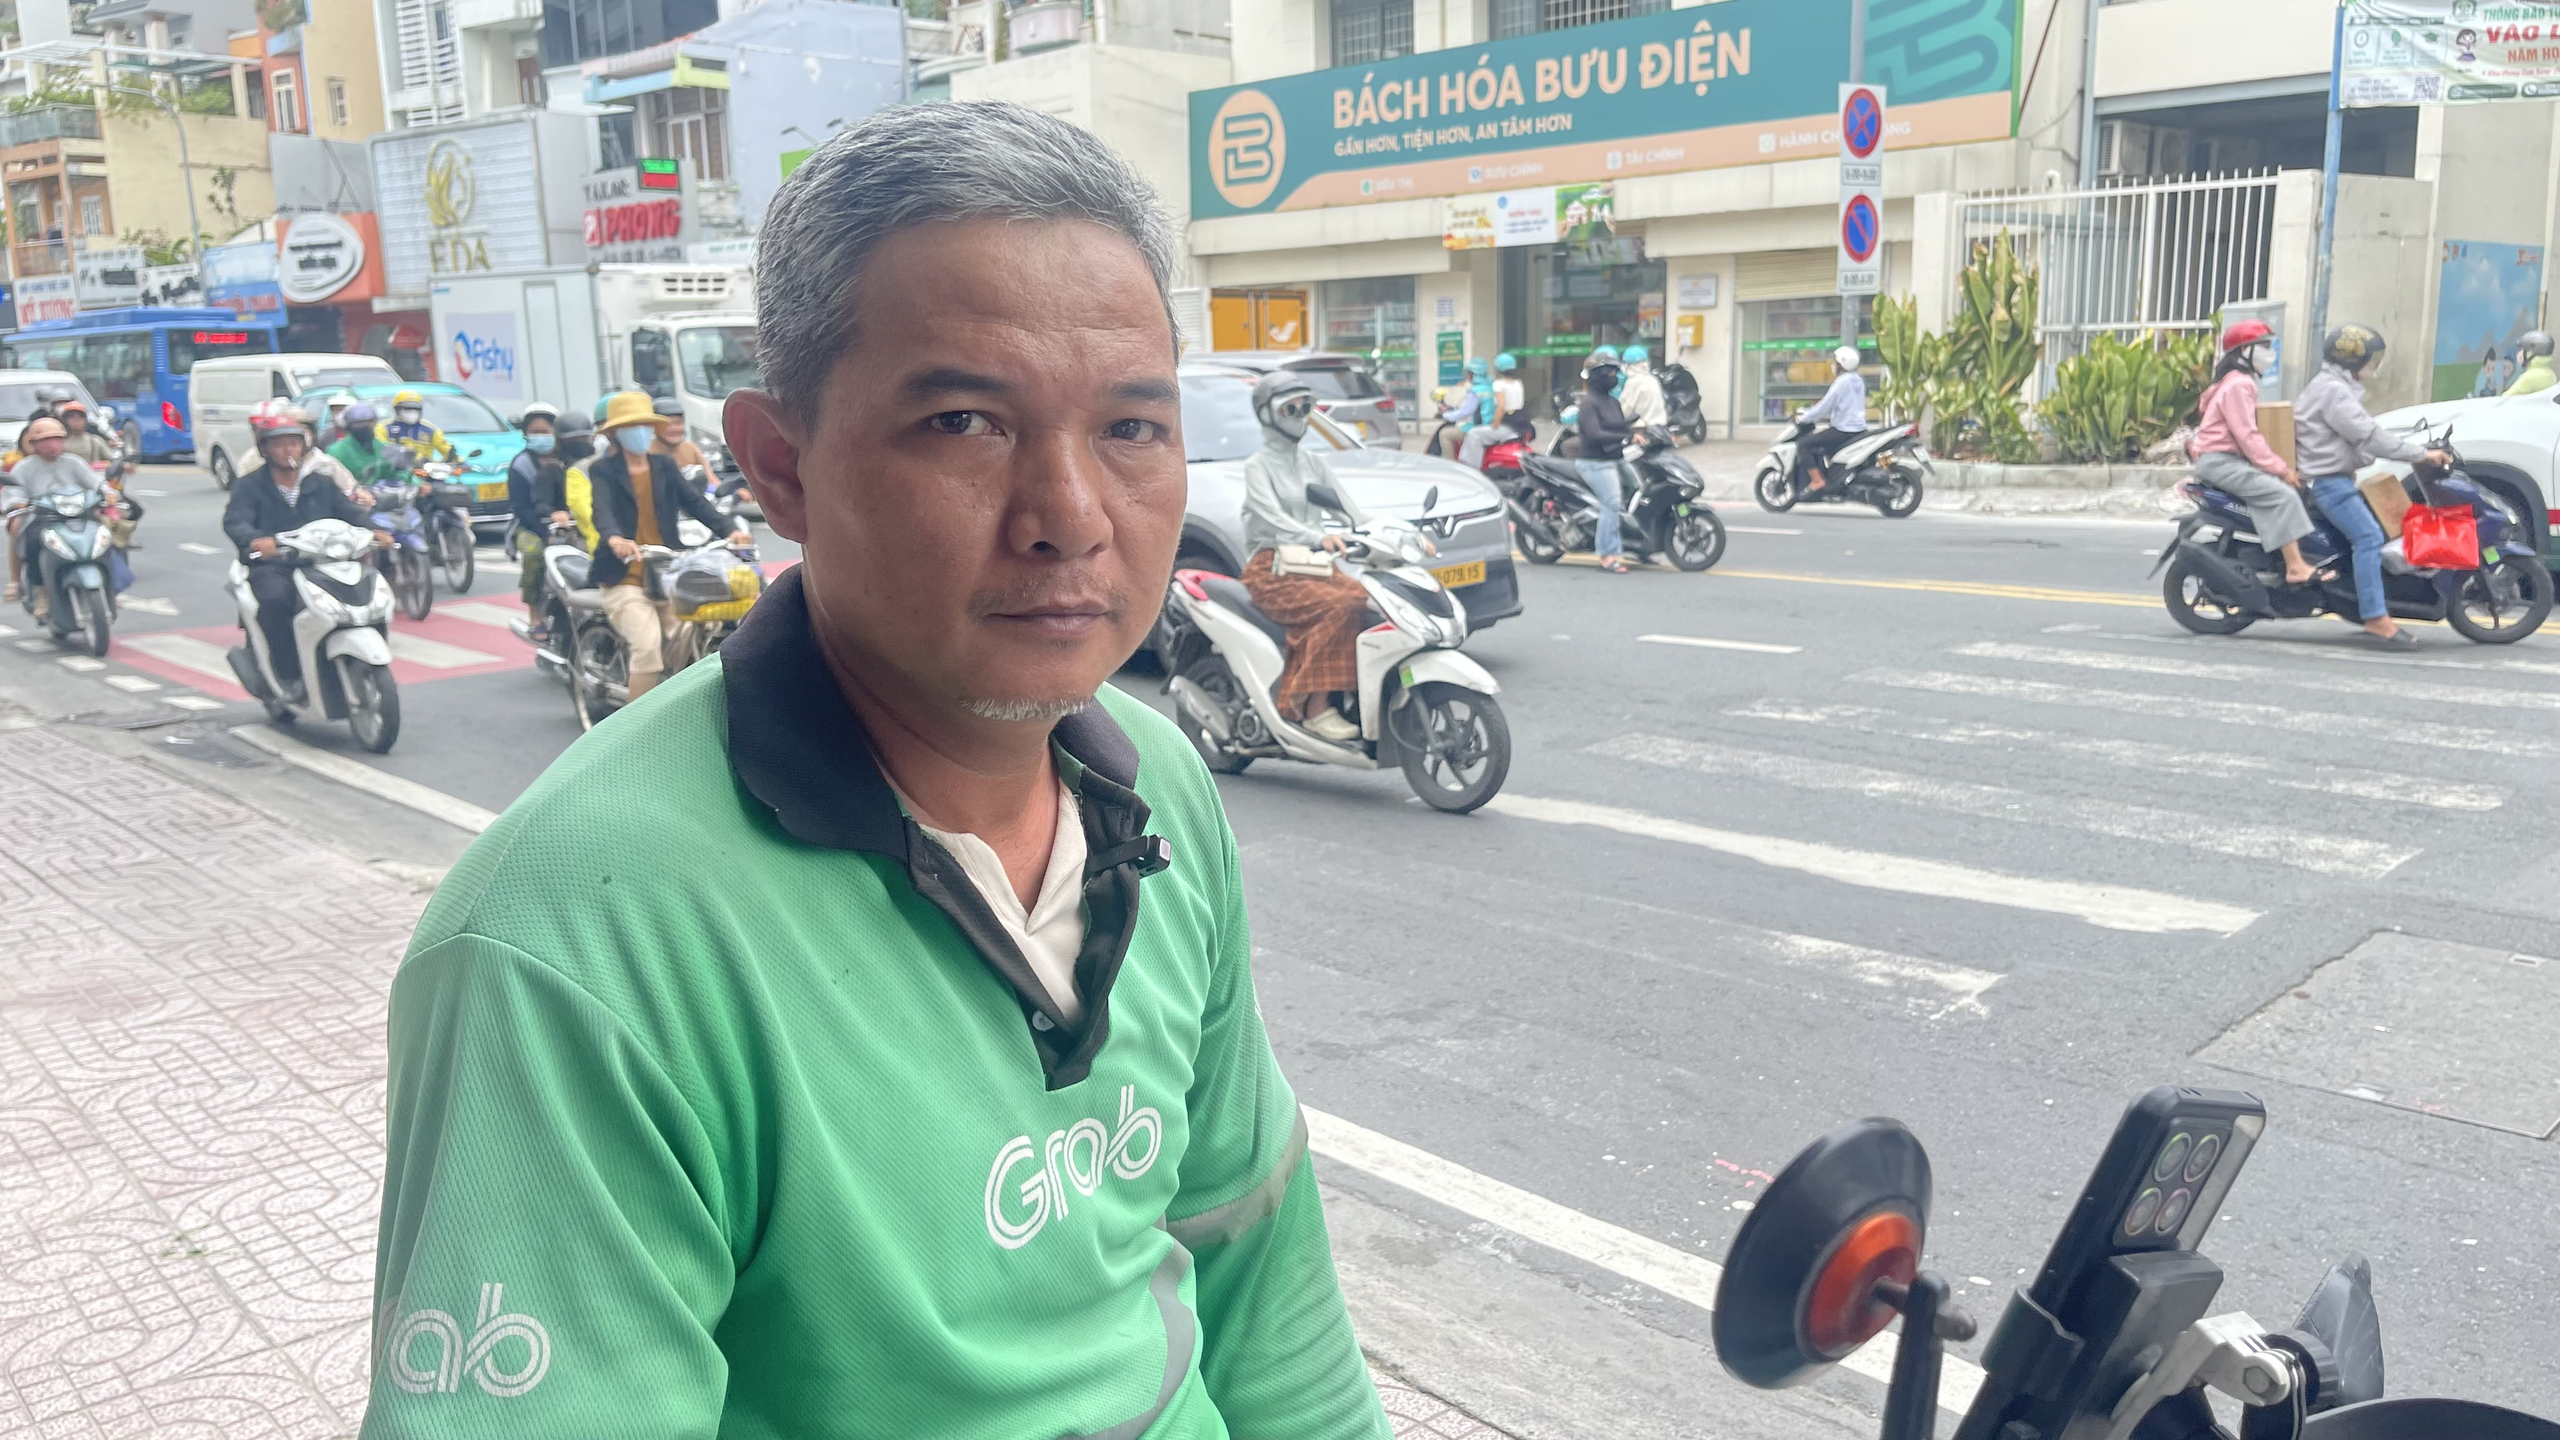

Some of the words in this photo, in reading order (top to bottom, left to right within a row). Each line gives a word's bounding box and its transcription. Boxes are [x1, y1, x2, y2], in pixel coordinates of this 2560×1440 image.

[1333, 72, 1429, 129] BÁCH
[1439, 54, 1525, 115] HÓA
[1535, 48, 1627, 103] BƯU
[1639, 20, 1750, 96] ĐIỆN
[1402, 127, 1434, 152] TIỆN
[1476, 122, 1498, 140] AN
[1535, 114, 1572, 134] HƠN
[984, 1084, 1162, 1250] Grab
